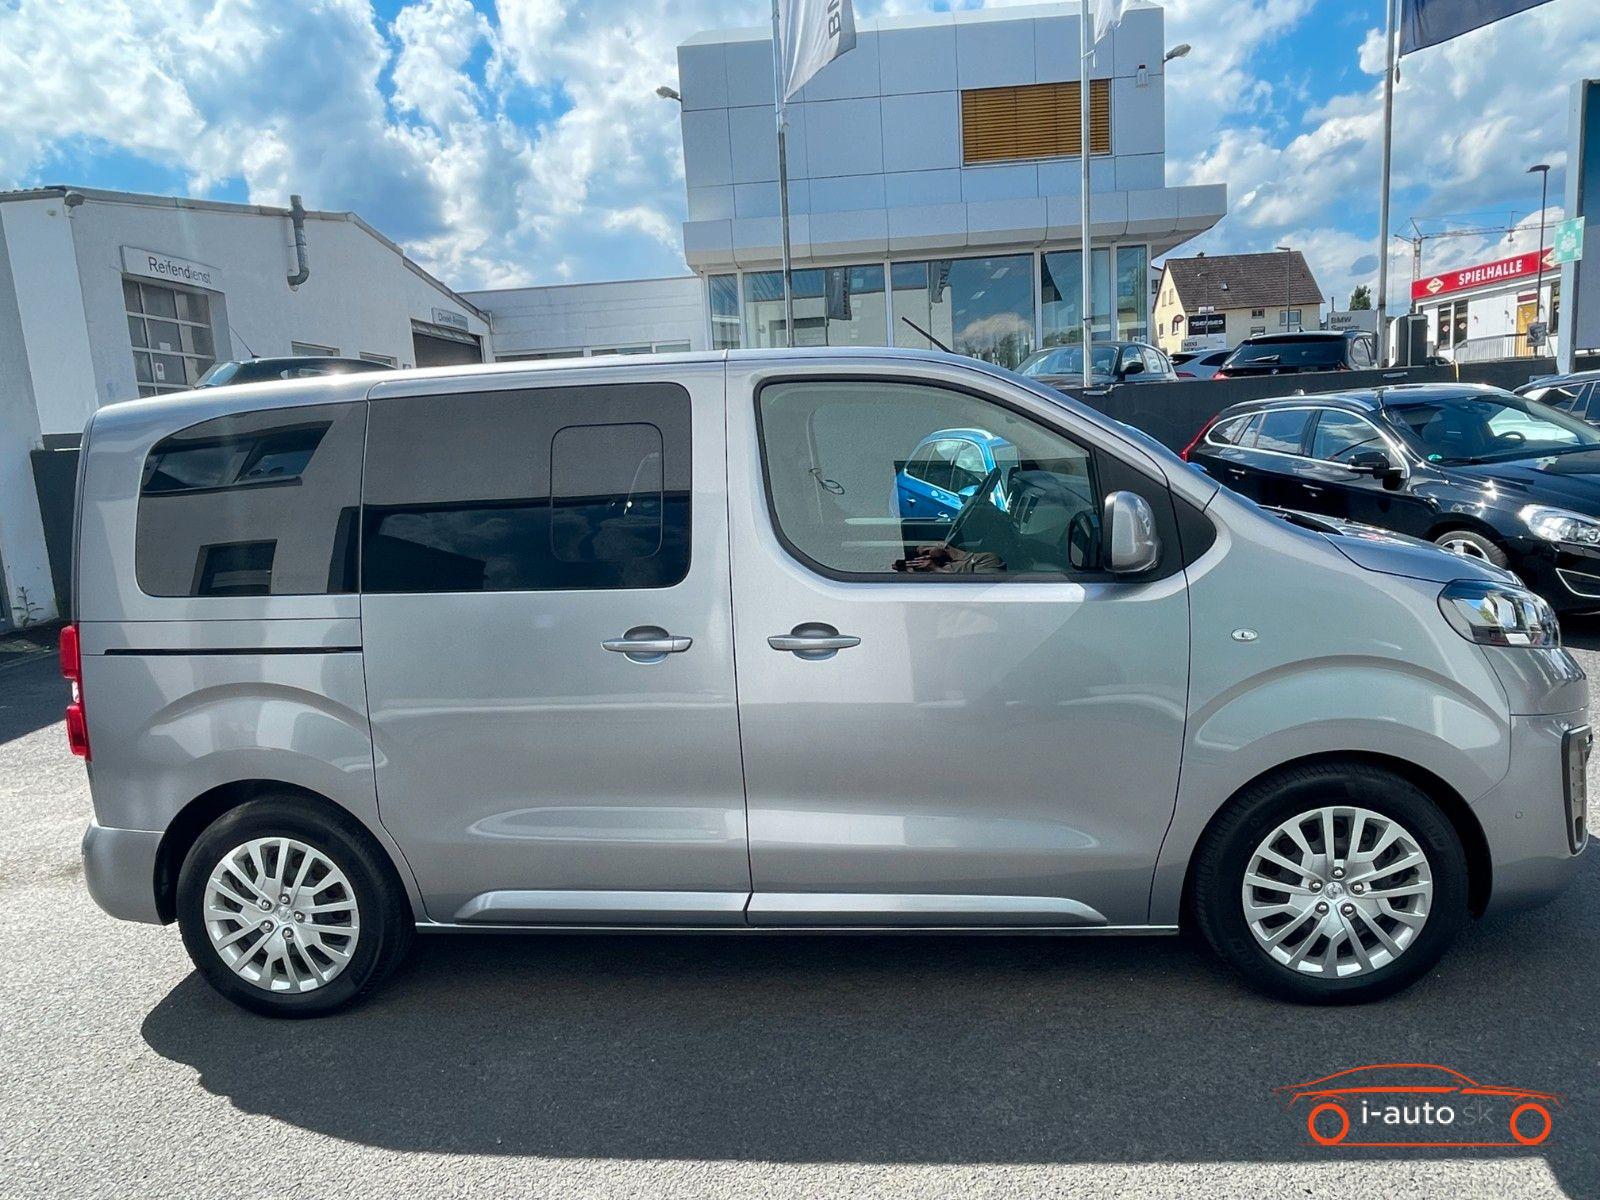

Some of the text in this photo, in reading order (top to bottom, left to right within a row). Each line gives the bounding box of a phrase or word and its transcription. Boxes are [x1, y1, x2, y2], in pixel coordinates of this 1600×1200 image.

[147, 256, 212, 284] Reifendienst
[1458, 259, 1523, 285] SPIELHALLE
[1331, 316, 1352, 324] BMW
